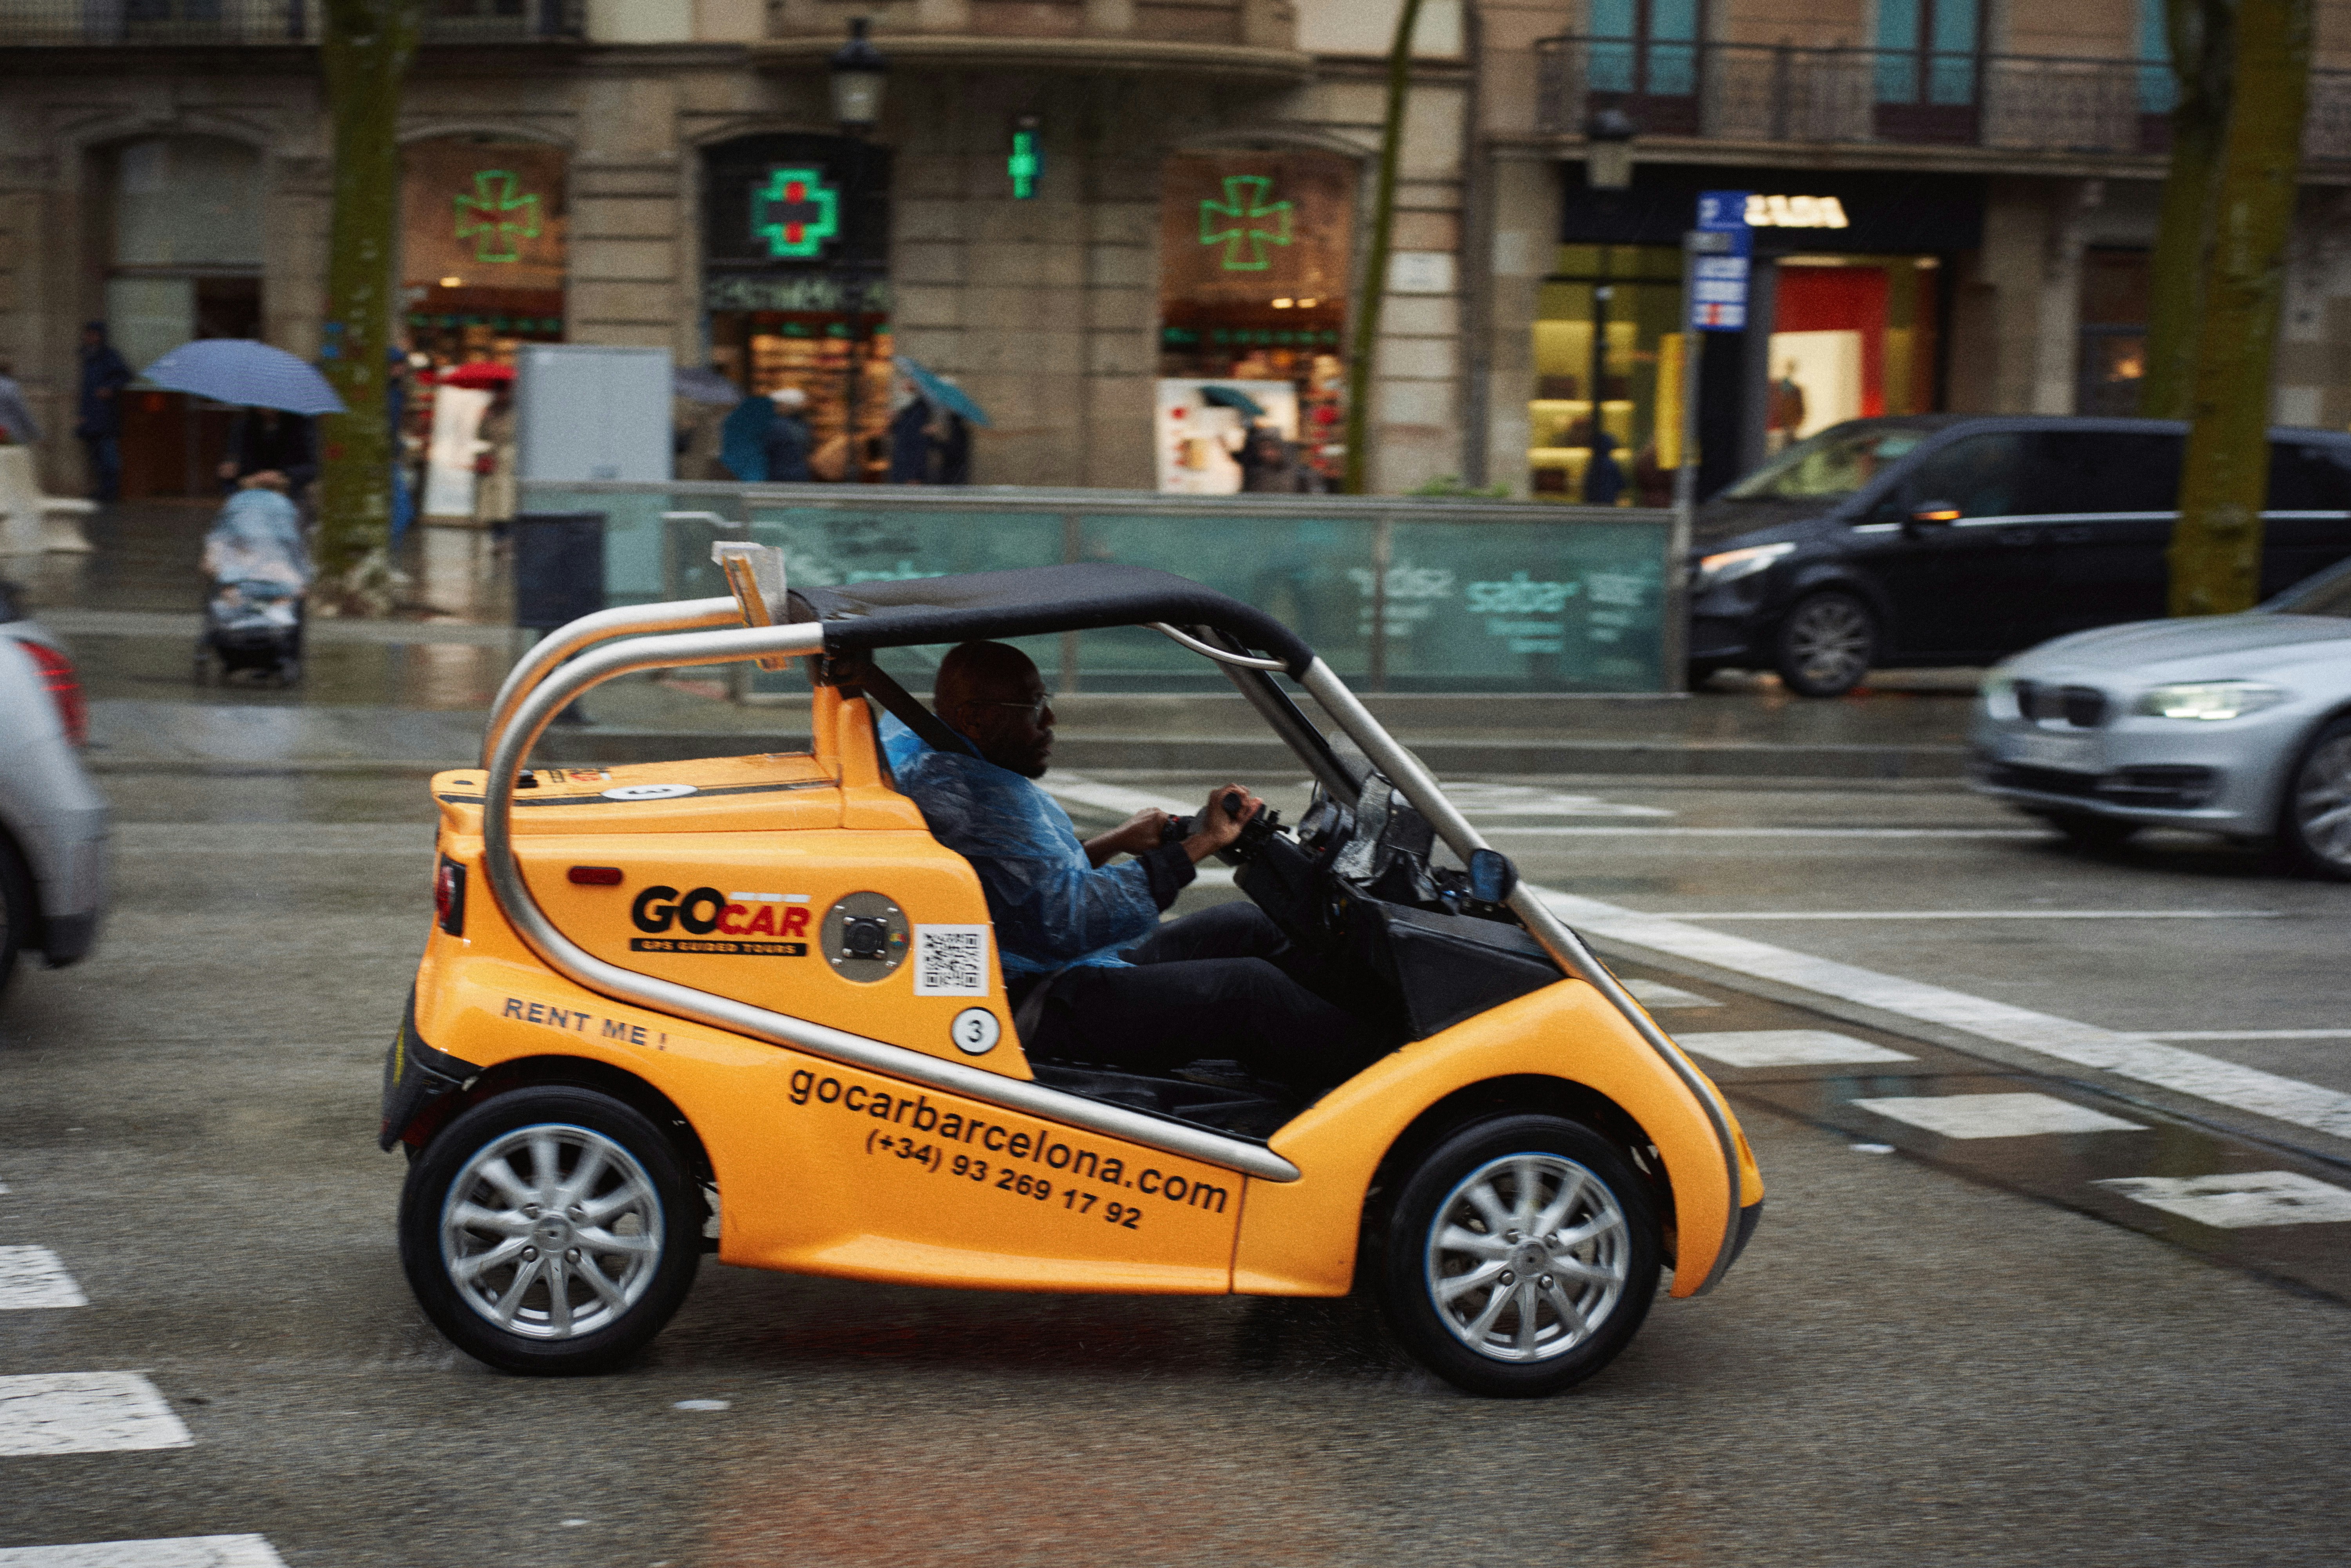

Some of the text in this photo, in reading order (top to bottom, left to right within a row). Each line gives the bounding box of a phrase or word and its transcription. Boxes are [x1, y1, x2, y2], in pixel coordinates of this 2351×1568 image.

[632, 885, 811, 937] GOCAR
[641, 941, 797, 954] GPS GUIDED TOURS
[504, 997, 591, 1032] RENT
[968, 1019, 982, 1043] 3
[789, 1069, 1227, 1213] gocarbarcelona.com
[865, 1128, 1142, 1229] (+34) 93 269 17 92
